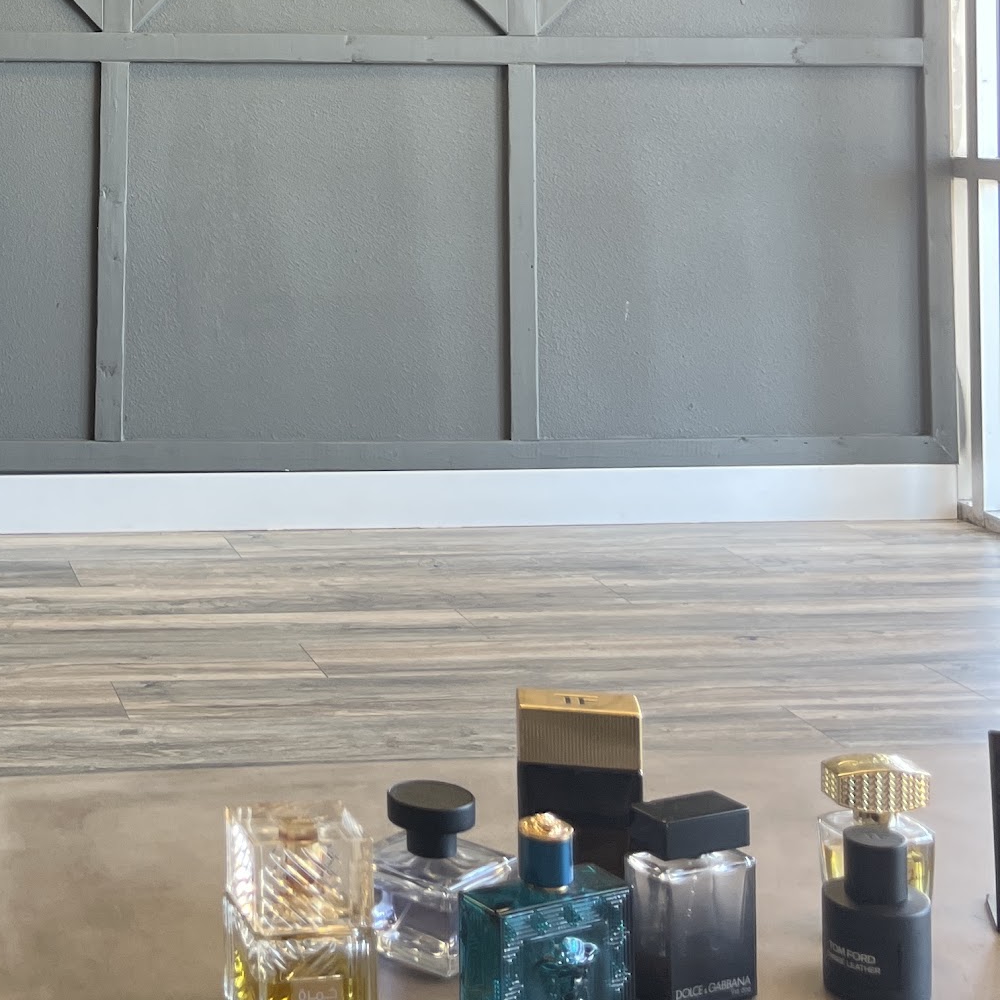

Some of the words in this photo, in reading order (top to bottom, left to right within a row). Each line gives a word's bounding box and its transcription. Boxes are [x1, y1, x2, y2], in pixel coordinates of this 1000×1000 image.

[828, 939, 846, 957] TOM
[846, 949, 876, 964] FORD
[846, 960, 881, 975] LEATHER
[675, 985, 703, 1000] DOLCE
[708, 975, 751, 993] GABBANA
